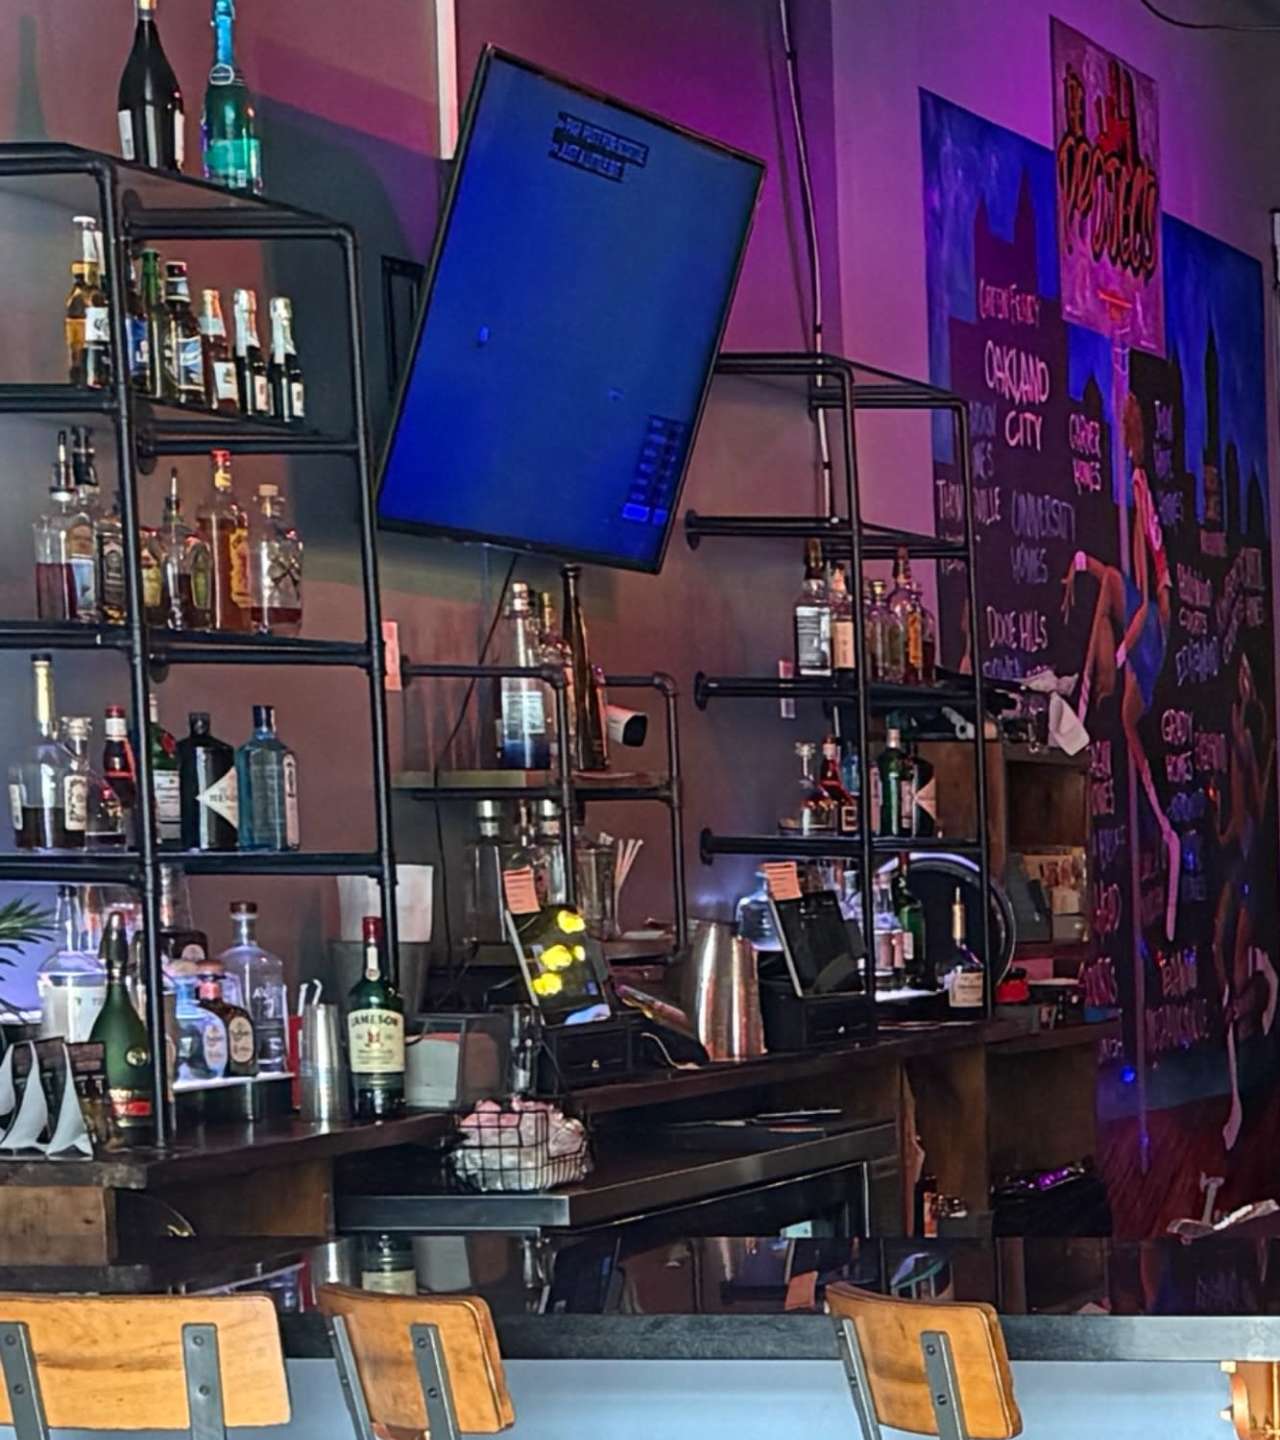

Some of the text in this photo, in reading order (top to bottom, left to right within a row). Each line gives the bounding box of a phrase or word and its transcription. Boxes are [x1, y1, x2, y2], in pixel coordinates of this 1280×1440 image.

[984, 339, 1050, 406] OAKLAND
[1004, 410, 1043, 452] CITY
[351, 1013, 398, 1028] JAMESON
